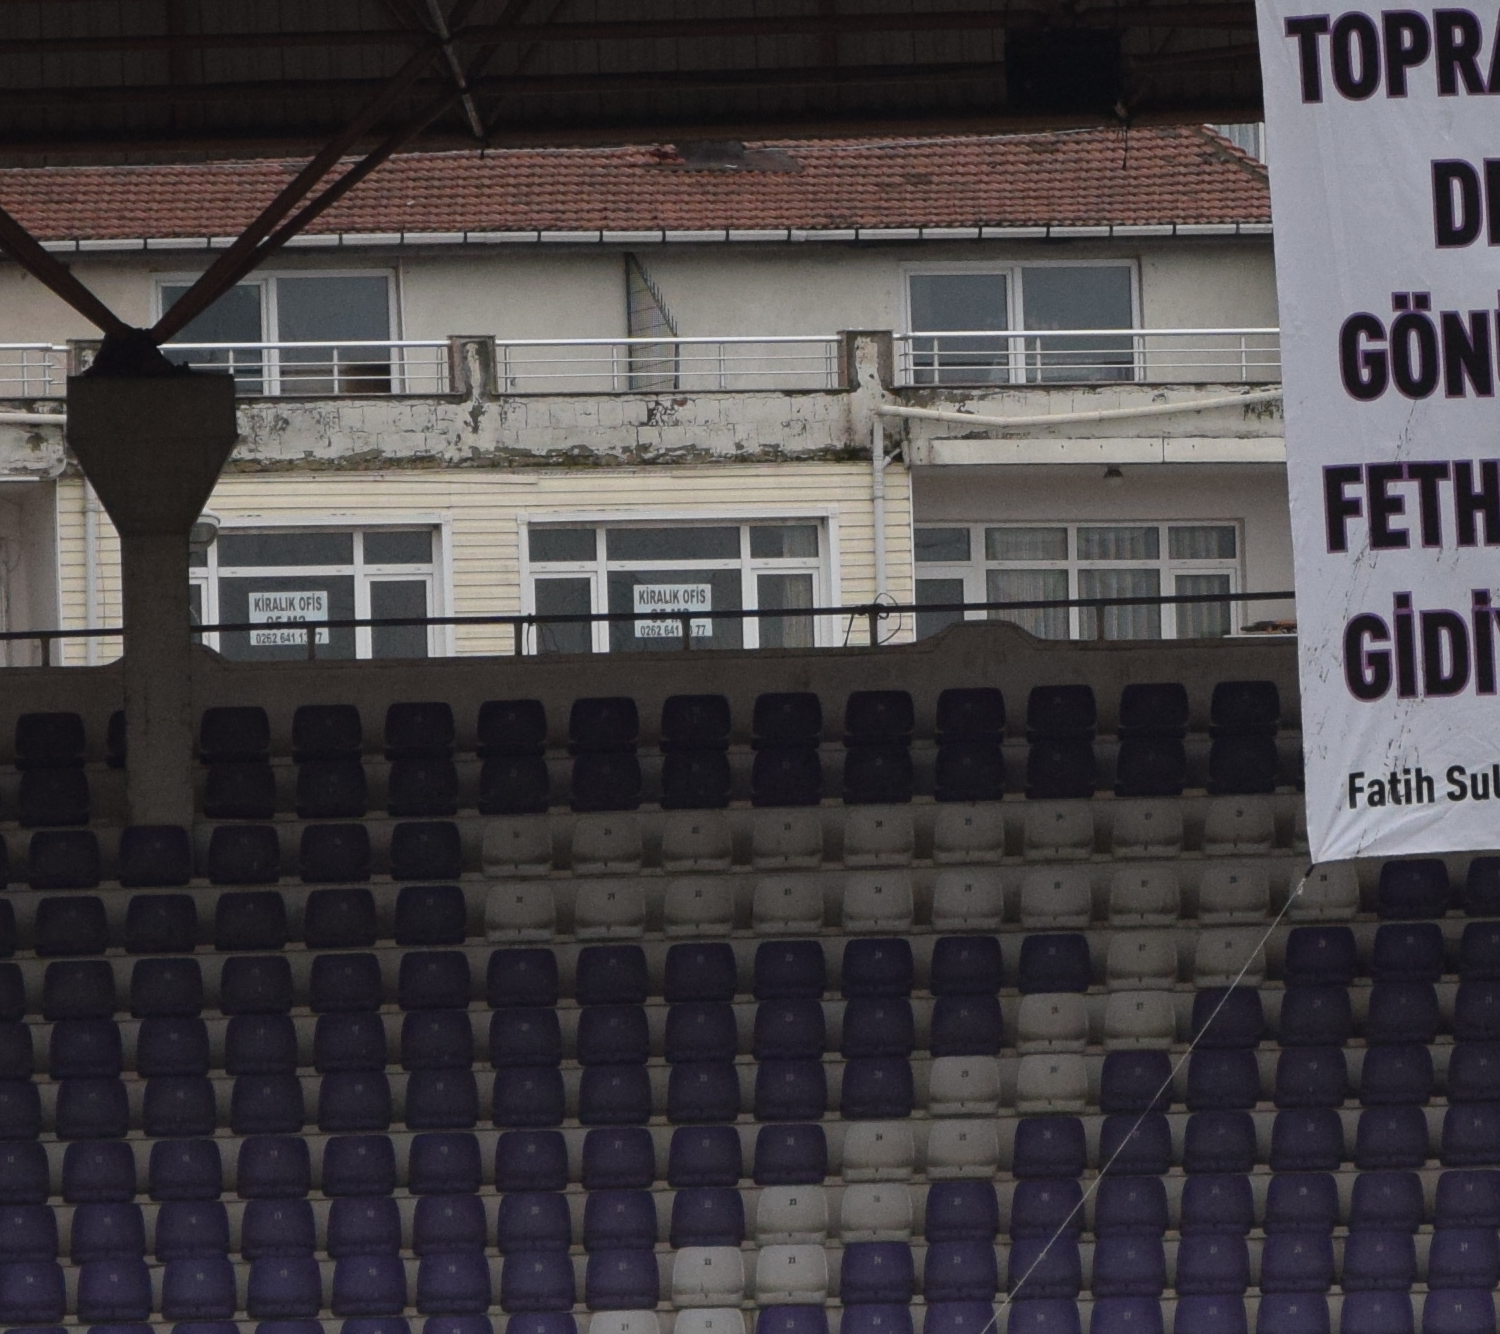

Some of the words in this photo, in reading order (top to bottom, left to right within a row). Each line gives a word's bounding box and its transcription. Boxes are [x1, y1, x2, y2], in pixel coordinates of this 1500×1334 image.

[254, 593, 296, 612] KİRALIK
[299, 592, 322, 611] OFİS
[639, 587, 680, 604] KİRALIK
[683, 586, 706, 604] OFİS
[256, 633, 278, 644] 0262
[640, 626, 662, 636] 0262
[1347, 765, 1435, 809] Fatih
